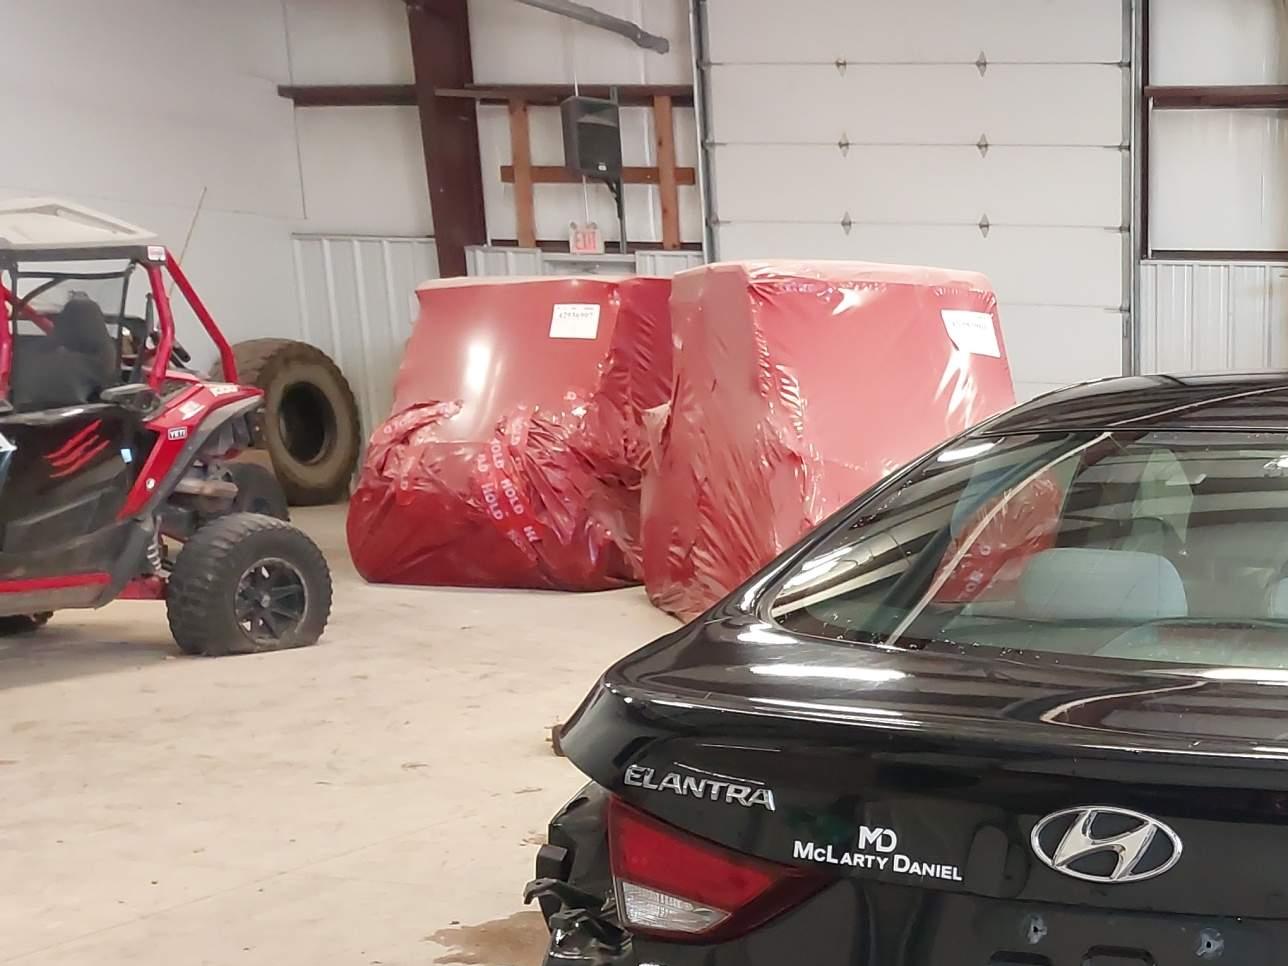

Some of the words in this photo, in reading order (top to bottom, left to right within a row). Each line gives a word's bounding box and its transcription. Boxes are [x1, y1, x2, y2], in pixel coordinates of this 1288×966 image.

[481, 482, 504, 520] HOLD
[500, 479, 524, 515] HOLD
[624, 764, 776, 812] ELANTRA
